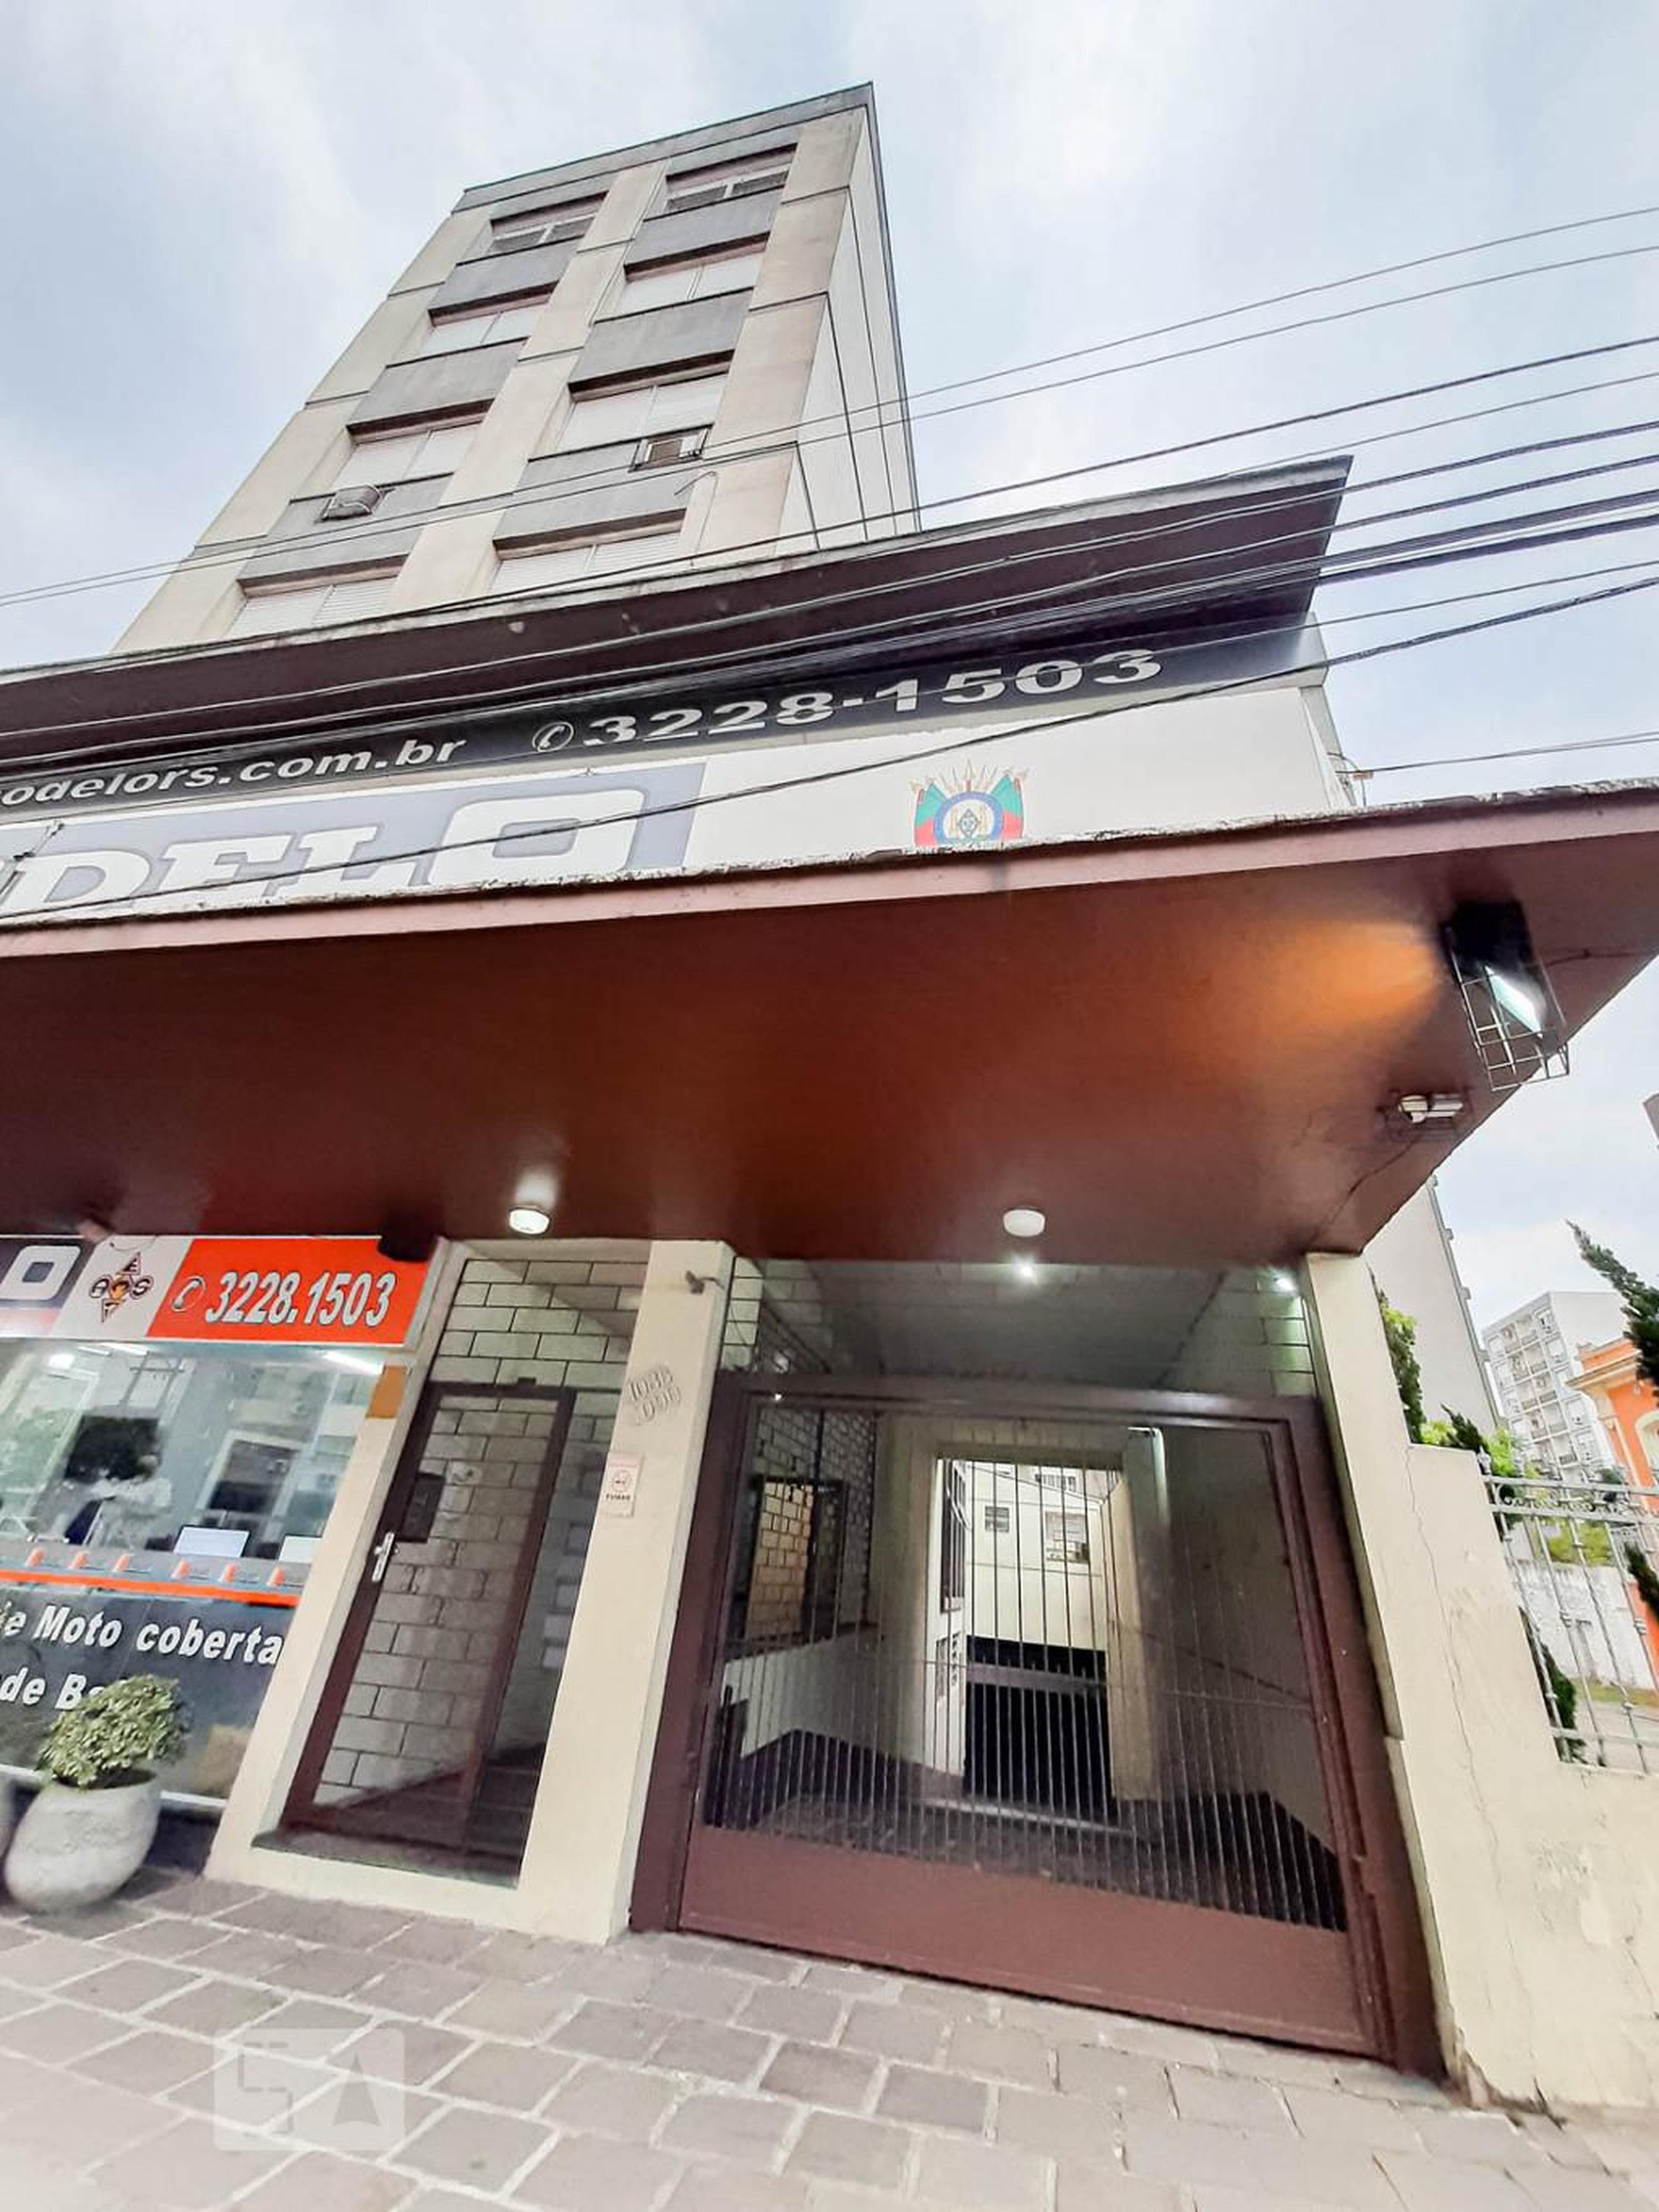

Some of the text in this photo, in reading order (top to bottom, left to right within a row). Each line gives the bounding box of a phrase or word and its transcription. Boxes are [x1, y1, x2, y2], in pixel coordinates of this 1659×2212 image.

[583, 649, 1162, 746] 3228-1503
[0, 738, 467, 806] odelors.com.br
[0, 789, 645, 913] DELO
[205, 1271, 396, 1326] 3228.1503
[33, 1605, 122, 1647] Moto
[136, 1618, 283, 1664] coberta
[0, 1667, 46, 1705] de
